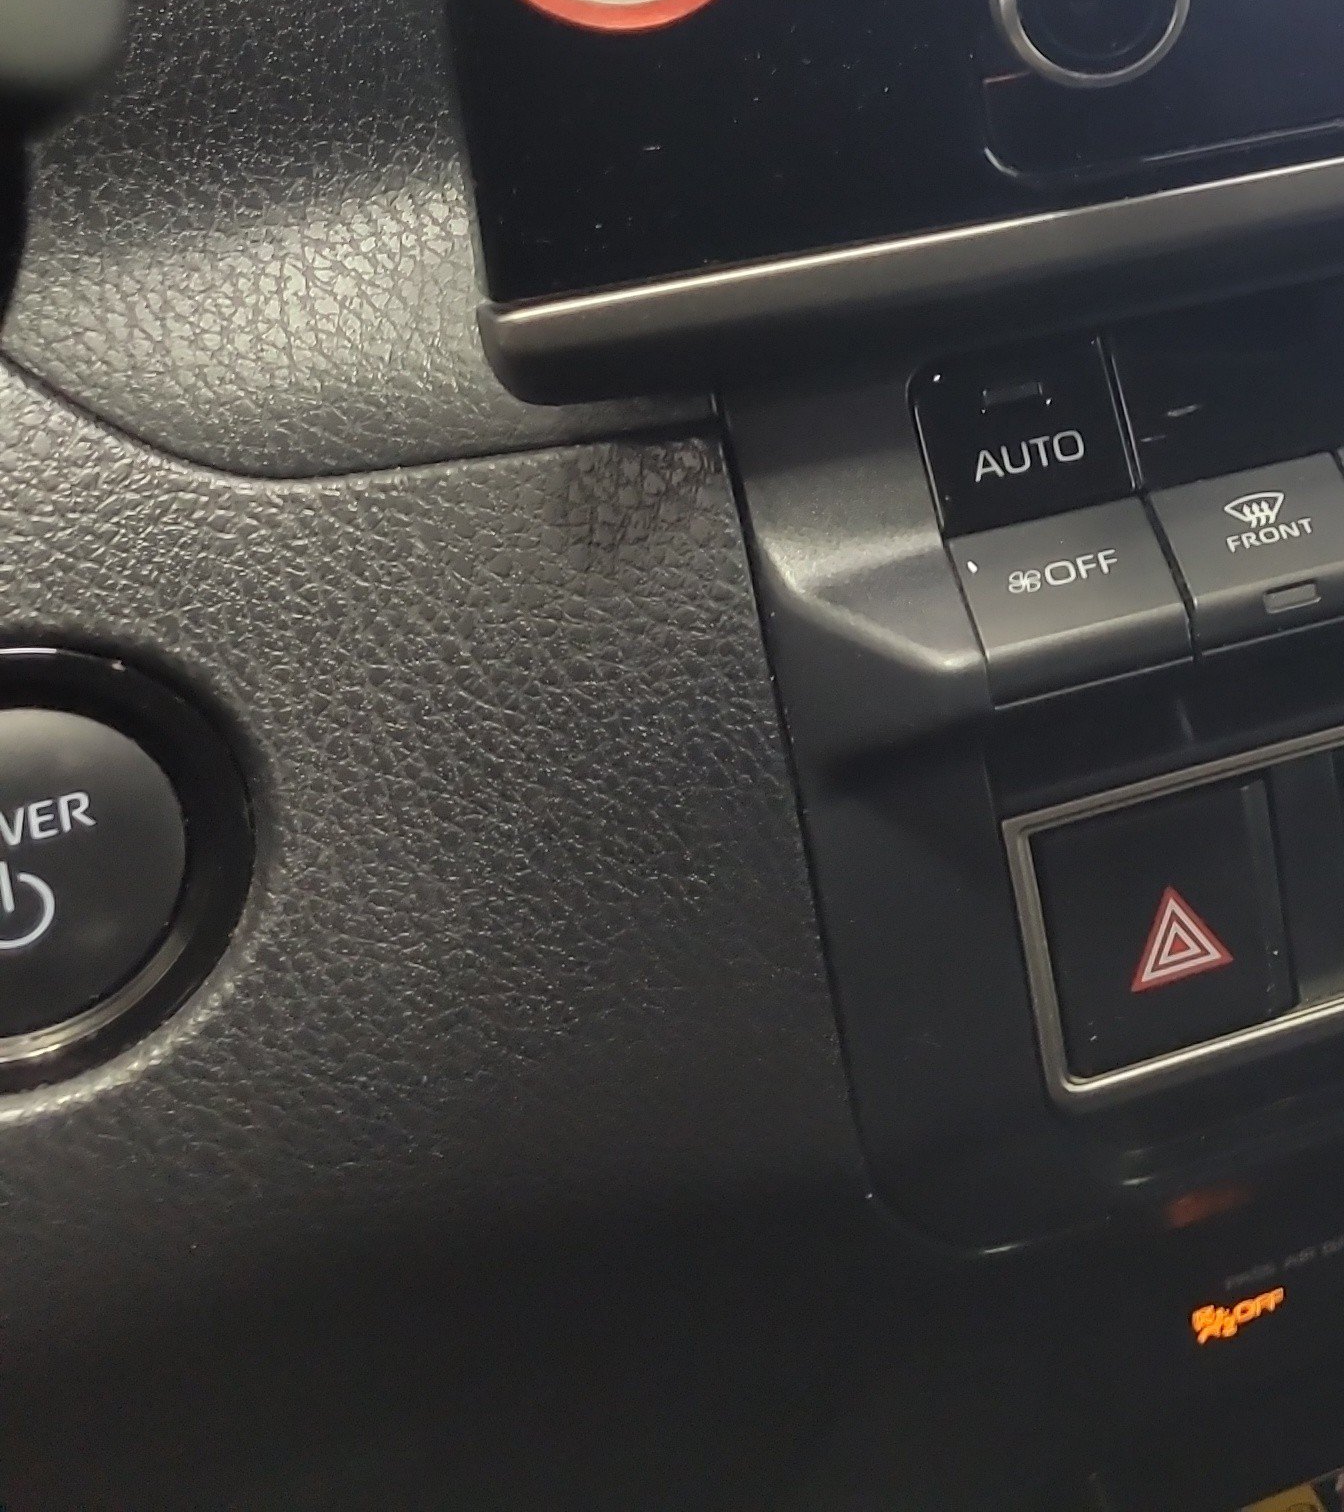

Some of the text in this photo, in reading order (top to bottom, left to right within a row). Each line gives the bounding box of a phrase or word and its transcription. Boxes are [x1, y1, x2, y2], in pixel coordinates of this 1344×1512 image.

[974, 429, 1085, 482] AUTO
[1225, 516, 1313, 553] FRONT
[1043, 549, 1118, 587] OFF
